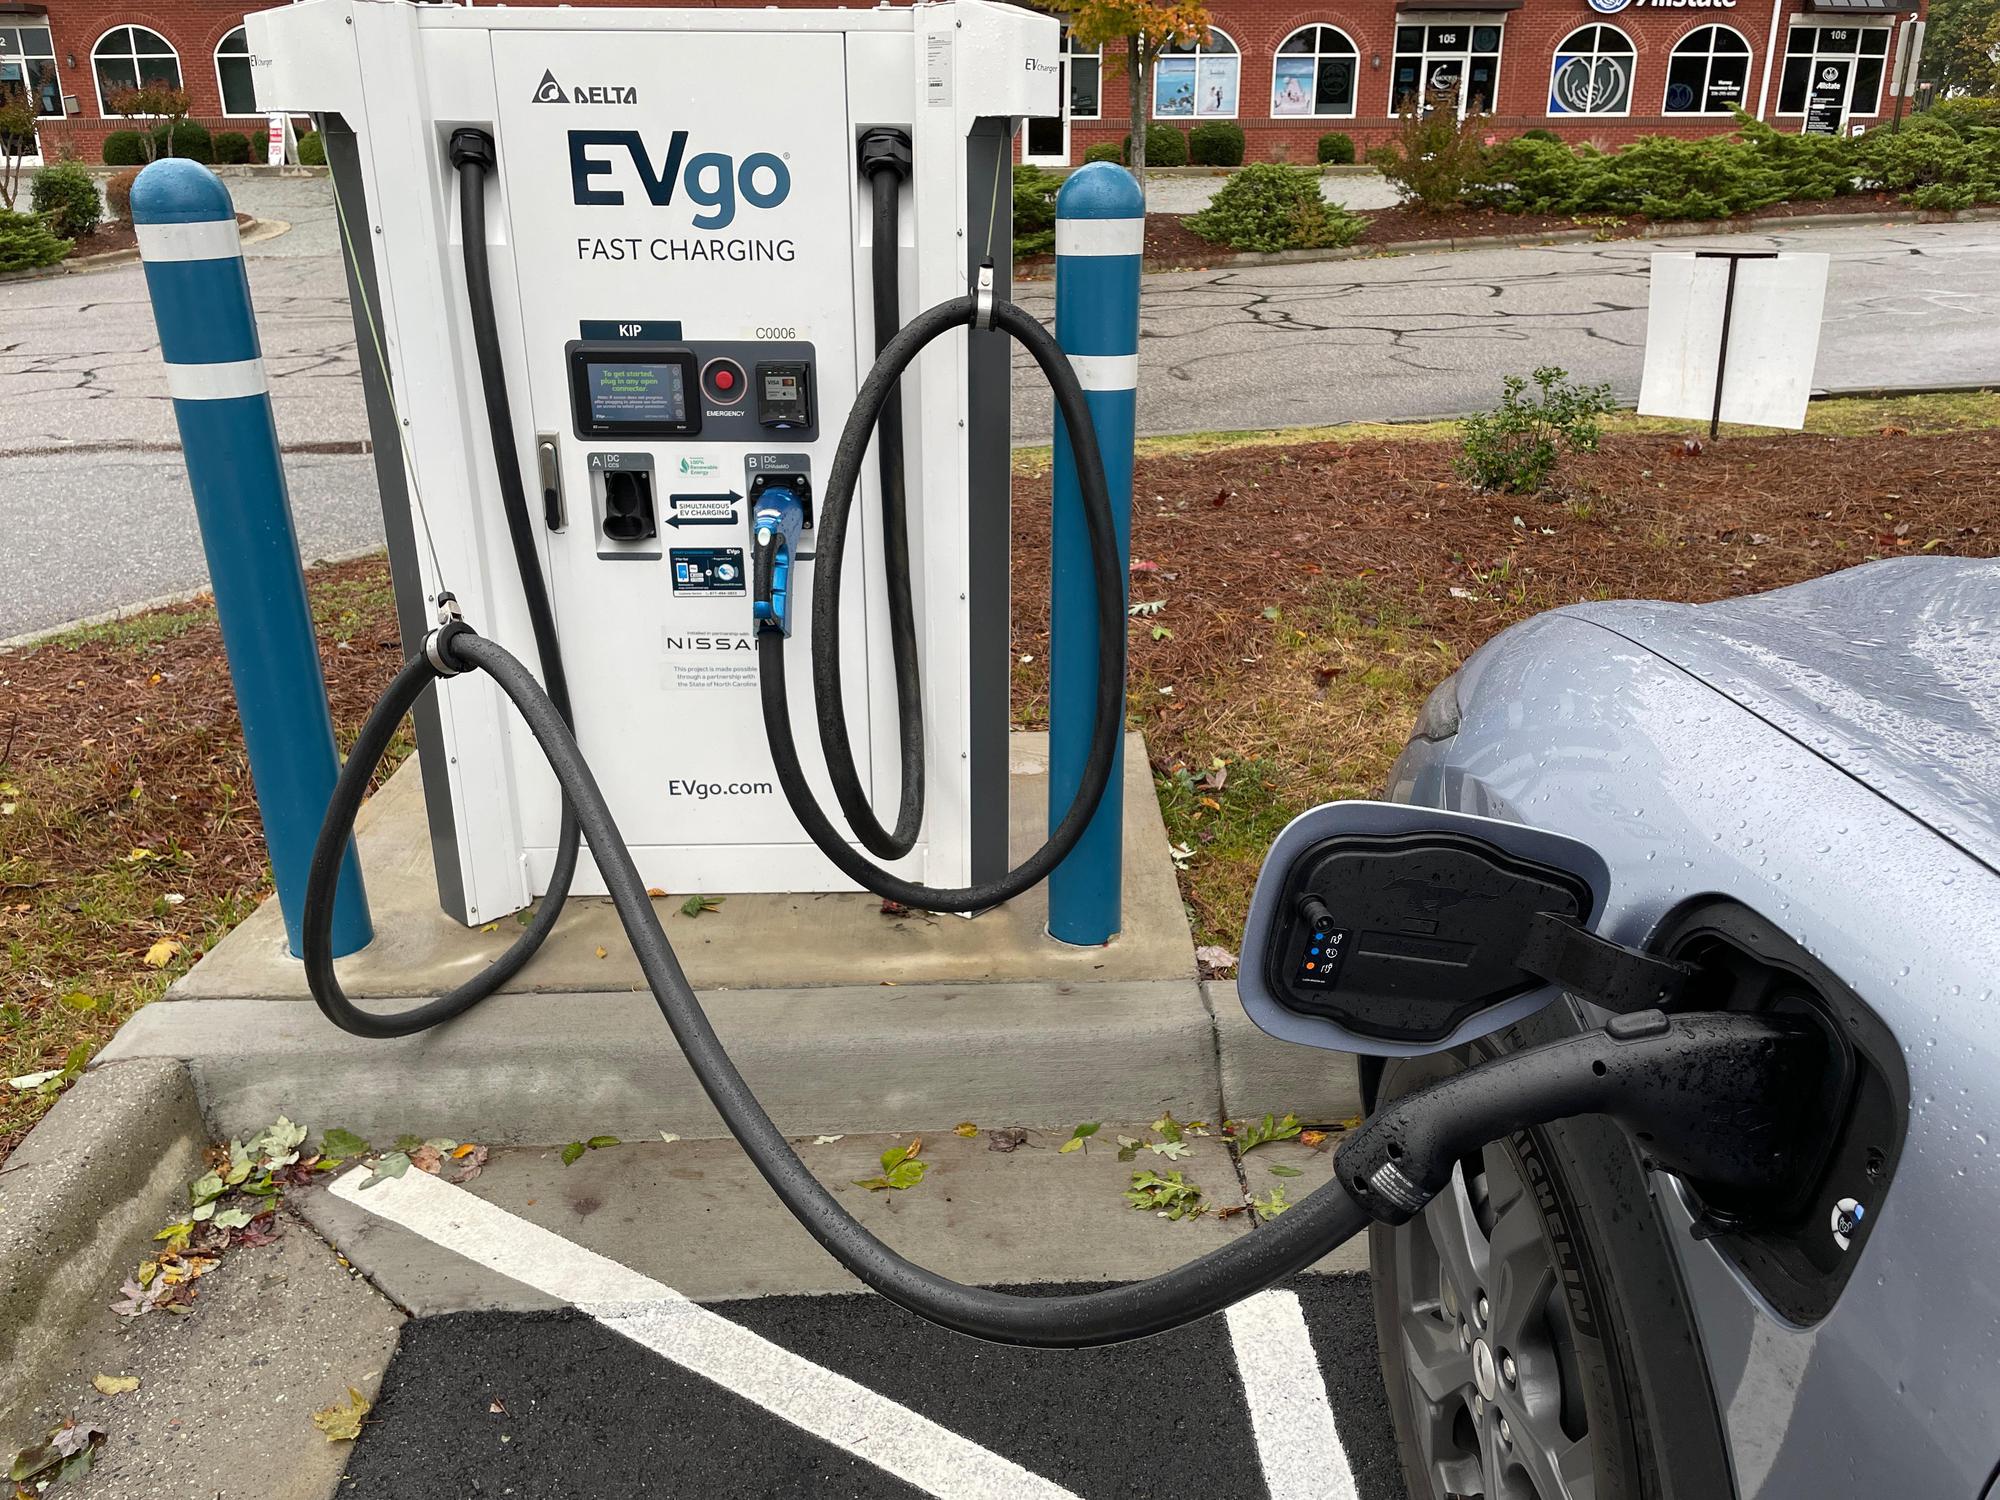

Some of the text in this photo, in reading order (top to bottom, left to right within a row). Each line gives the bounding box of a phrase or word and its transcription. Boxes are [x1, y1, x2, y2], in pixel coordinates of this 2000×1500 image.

[1438, 34, 1456, 43] 105
[1830, 30, 1847, 39] 106
[1025, 58, 1058, 74] EV Charger
[574, 86, 638, 104] DELTA
[577, 238, 796, 261] FAST CHARGING
[619, 324, 642, 337] KIP
[755, 327, 796, 340] C0006
[613, 370, 625, 379] get
[627, 370, 654, 378] started,
[601, 378, 616, 386] plug
[592, 454, 620, 467] A DC
[748, 455, 777, 468] B DC
[669, 779, 773, 800] EVgo.com
